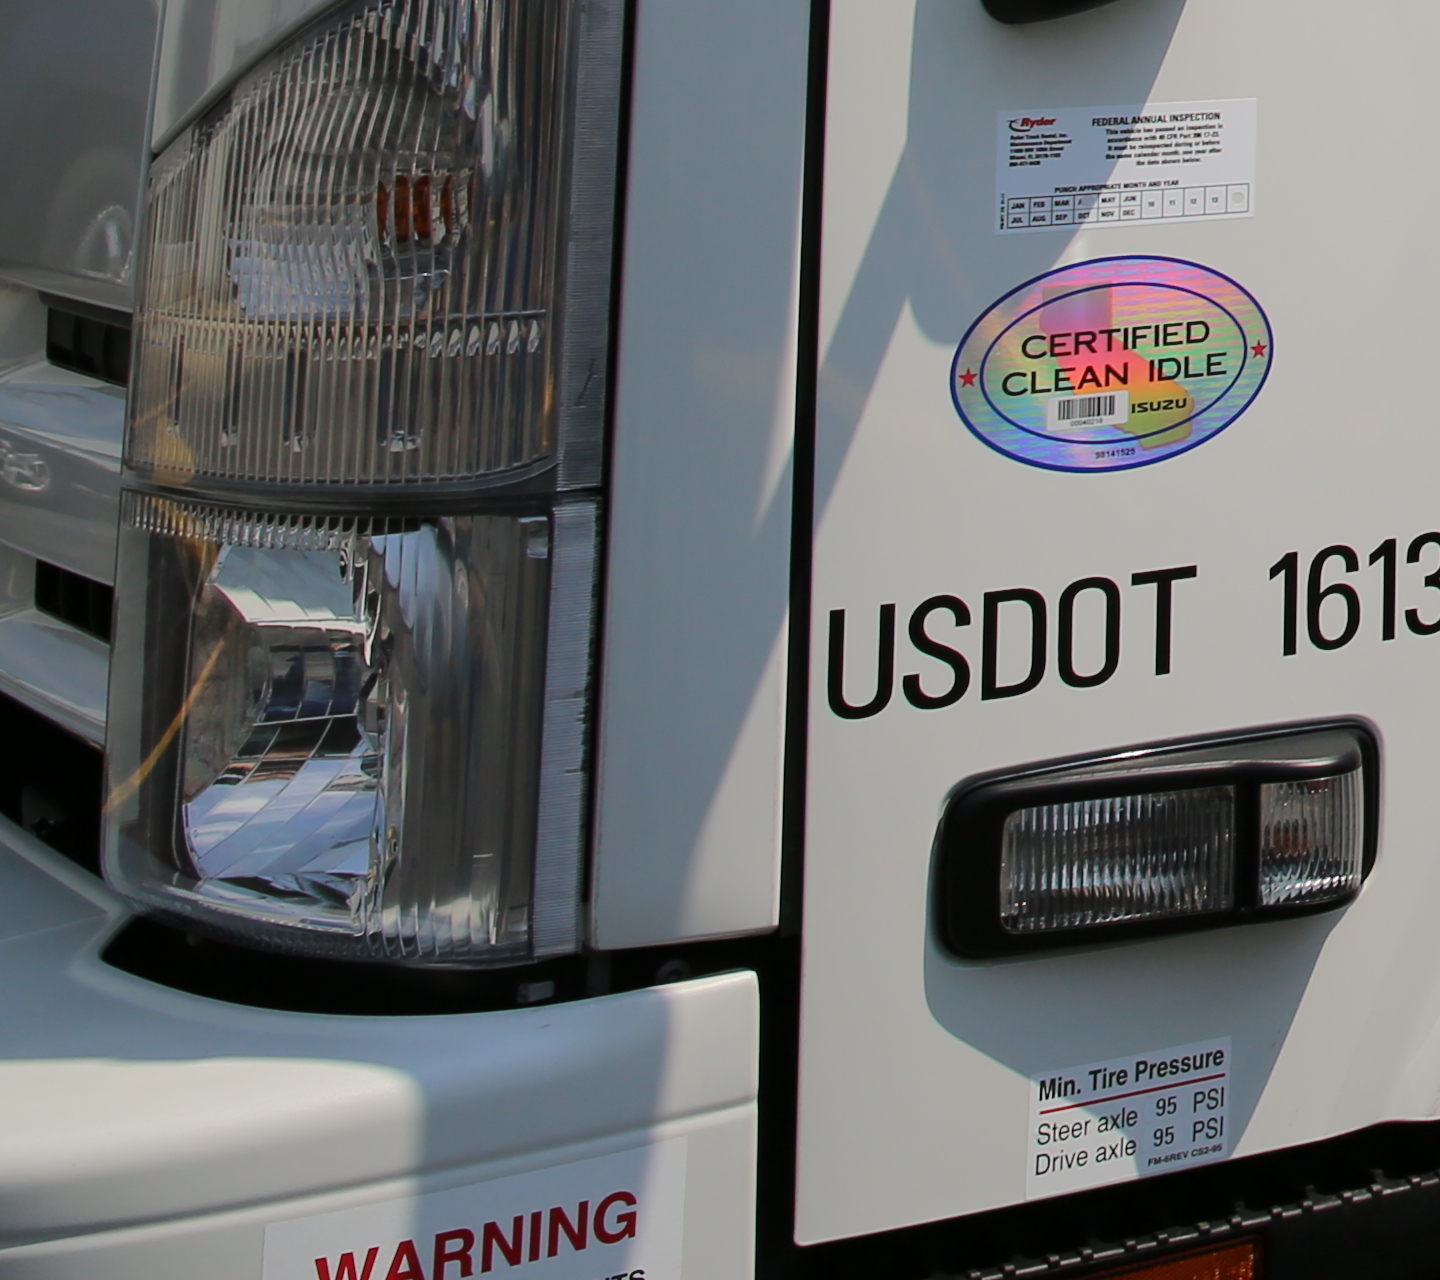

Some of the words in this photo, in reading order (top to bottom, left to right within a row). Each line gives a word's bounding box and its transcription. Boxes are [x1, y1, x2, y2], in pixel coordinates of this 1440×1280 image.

[1020, 117, 1057, 129] Ryder
[1092, 117, 1129, 127] FEDERAL
[1131, 115, 1167, 125] ANNUAL
[1169, 112, 1221, 122] INSPECTION
[1021, 320, 1210, 359] CERTIFIED
[1002, 362, 1128, 397] CLEAN
[1149, 352, 1228, 382] IDLE
[1131, 398, 1187, 414] ISUZU
[826, 564, 1197, 720] USDOT
[1039, 1076, 1081, 1102] Min.
[1088, 1067, 1128, 1091] Tire
[1135, 1049, 1225, 1082] Pressure
[1036, 1119, 1091, 1145] Steer
[1097, 1107, 1138, 1133] axle
[1155, 1096, 1177, 1117] 95
[1192, 1086, 1225, 1113] PSI
[1035, 1149, 1088, 1176] Drive
[1095, 1137, 1137, 1163] axle
[1153, 1126, 1175, 1147] 95
[1191, 1116, 1225, 1143] PSI
